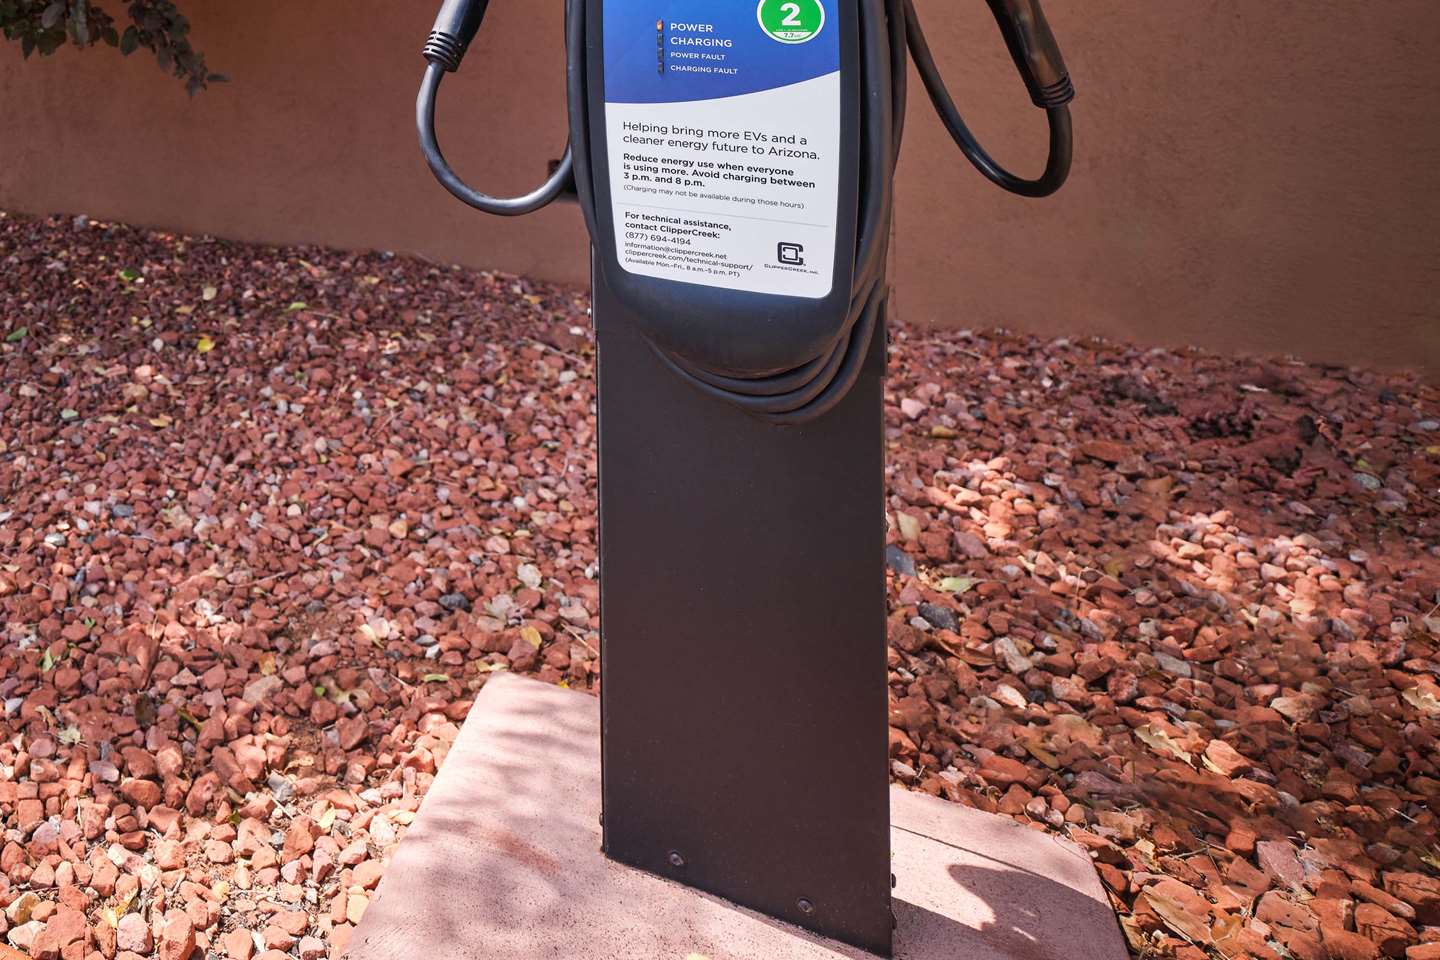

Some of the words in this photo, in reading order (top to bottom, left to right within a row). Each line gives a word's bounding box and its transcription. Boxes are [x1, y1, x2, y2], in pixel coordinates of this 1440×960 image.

[780, 2, 802, 26] 2
[670, 22, 713, 33] POWER
[670, 36, 733, 48] CHARGING
[670, 51, 700, 59] POWER
[701, 53, 726, 61] FAULT
[670, 65, 712, 73] CHARGING
[623, 121, 668, 135] Helping
[672, 125, 703, 138] bring
[708, 130, 740, 139] more
[744, 131, 767, 142] EVs
[771, 135, 796, 144] and
[799, 137, 807, 145] a
[623, 134, 664, 146] cleaner
[668, 139, 709, 151] energy
[712, 141, 748, 153] future
[751, 145, 765, 155] to
[768, 146, 820, 160] Arizona.
[623, 153, 658, 163] Reduce
[661, 158, 695, 168] energy
[717, 162, 744, 171] when
[747, 165, 794, 176] everyone
[623, 162, 631, 170] is
[633, 164, 659, 174] using
[661, 167, 689, 176] more.
[691, 169, 720, 179] Avoid
[723, 172, 767, 185] charging
[770, 176, 816, 188] between
[655, 176, 673, 184] and
[675, 177, 681, 185] 8
[684, 179, 705, 187] p.m.
[623, 184, 657, 194] (Charging
[659, 188, 673, 196] may
[699, 192, 730, 201] available
[731, 195, 756, 204] during
[757, 198, 778, 206] those
[779, 201, 805, 209] hours)
[625, 211, 640, 219] For
[642, 213, 681, 224] technical
[683, 219, 732, 231] assistance,
[625, 222, 657, 231] contact
[660, 225, 720, 238] ClipperCreek:
[625, 231, 648, 241] (877)
[650, 234, 691, 245] 694-4194
[625, 241, 727, 259] information@clippercreek.net
[625, 249, 753, 271] clippercreek.com/technical-support/
[625, 257, 655, 265] (Available
